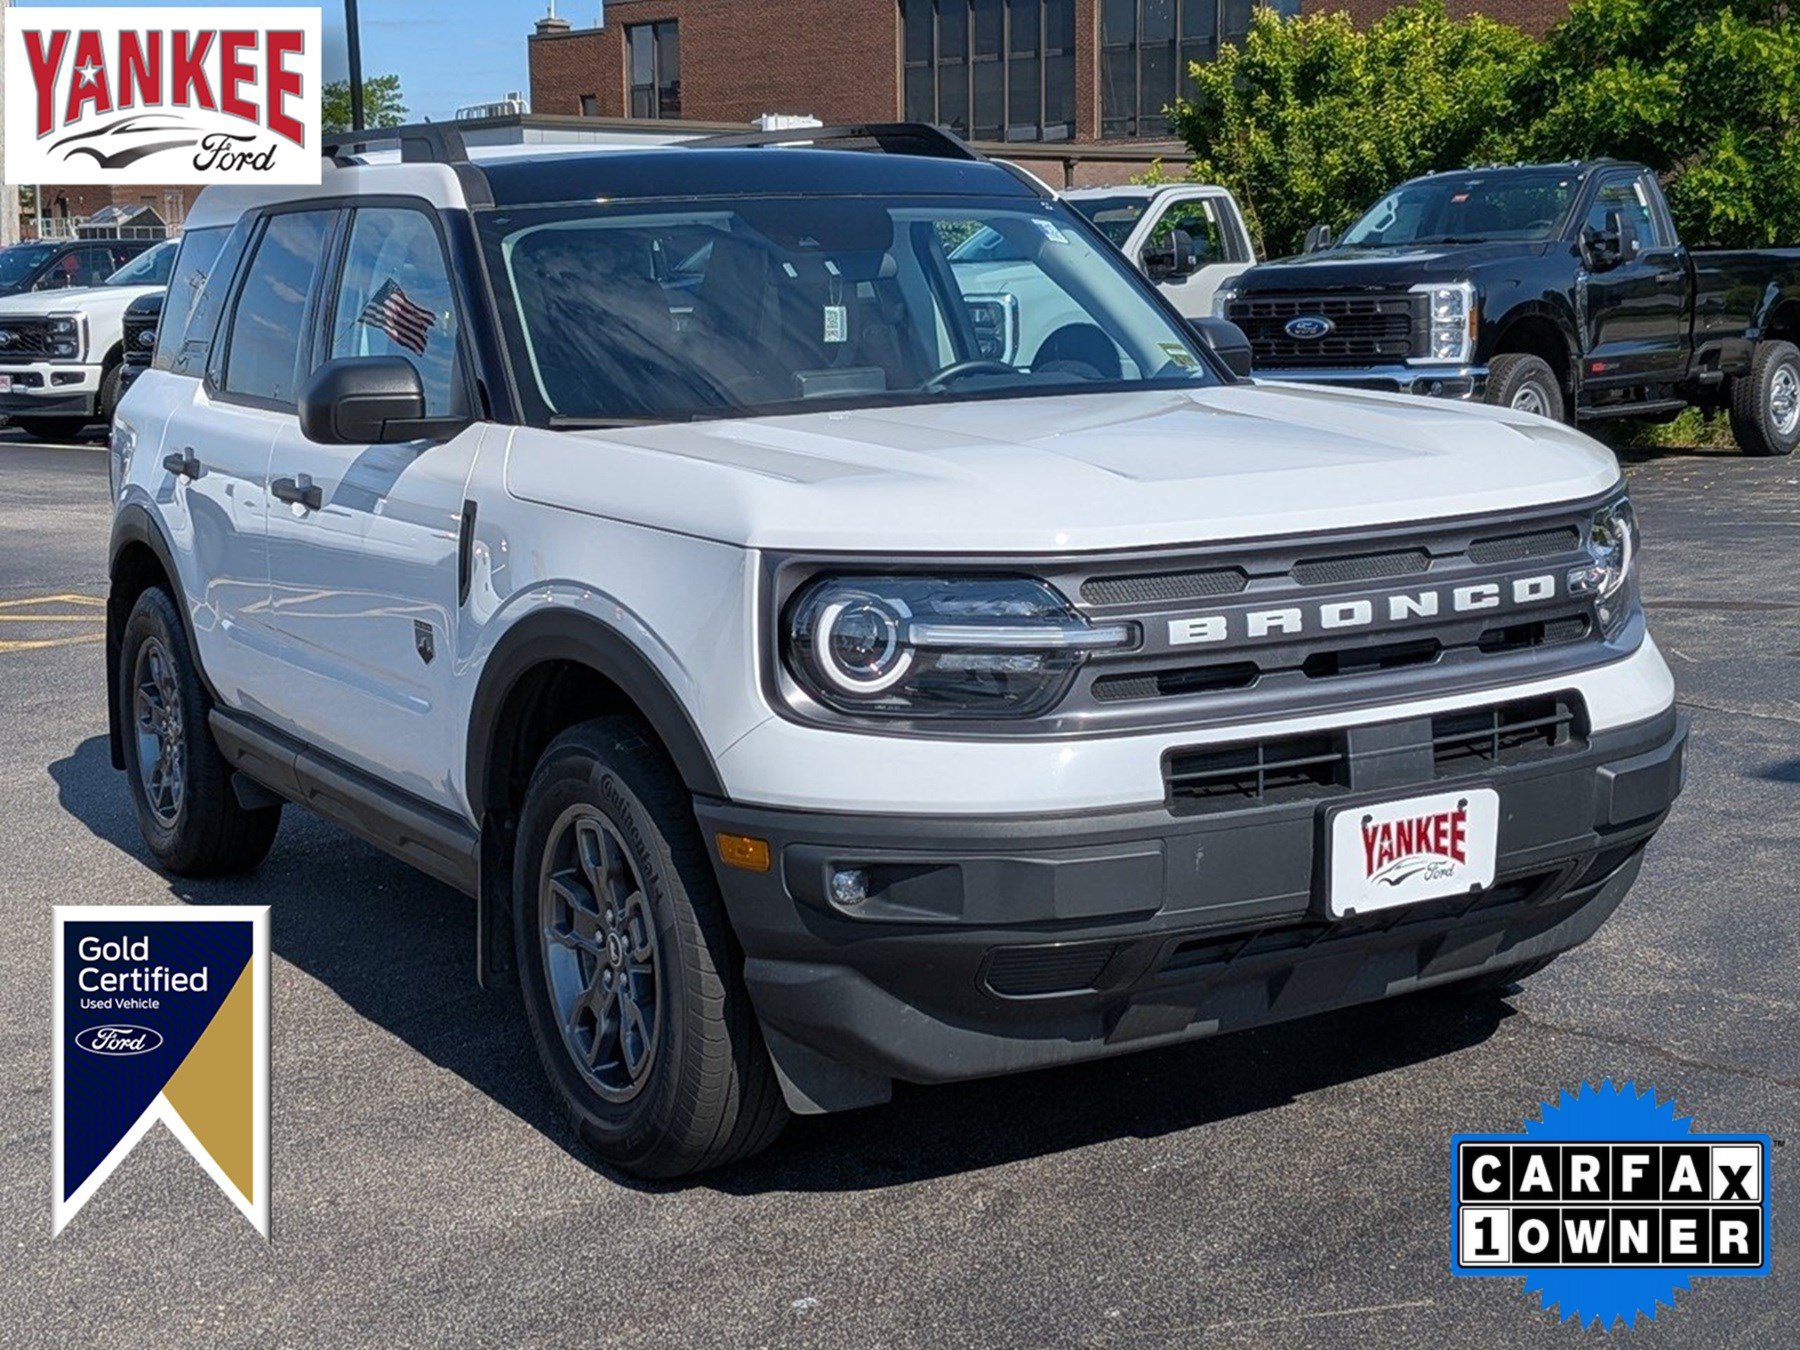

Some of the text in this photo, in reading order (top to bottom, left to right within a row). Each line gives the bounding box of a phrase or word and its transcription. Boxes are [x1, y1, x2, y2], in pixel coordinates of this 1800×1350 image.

[1167, 574, 1556, 647] BRONCO
[1361, 809, 1467, 879] YANKEE
[1423, 860, 1456, 881] Ford
